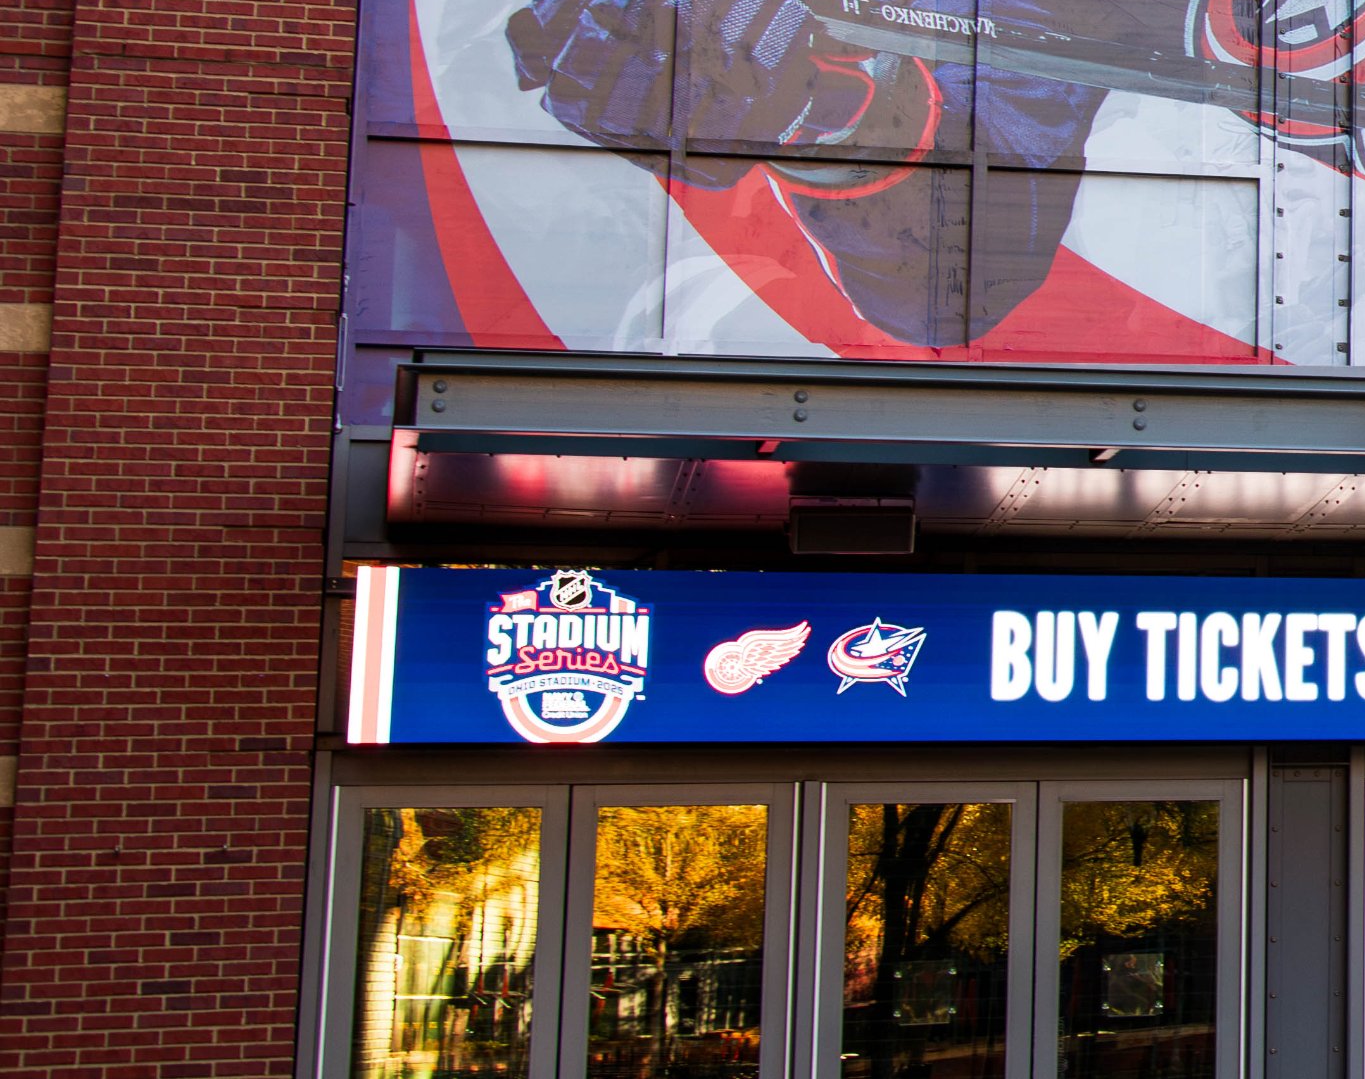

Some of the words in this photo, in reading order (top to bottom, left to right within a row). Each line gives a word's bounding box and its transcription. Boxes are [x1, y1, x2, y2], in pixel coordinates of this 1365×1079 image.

[486, 613, 650, 669] STADIUM
[514, 645, 621, 675] Series
[990, 610, 1120, 702] BUY
